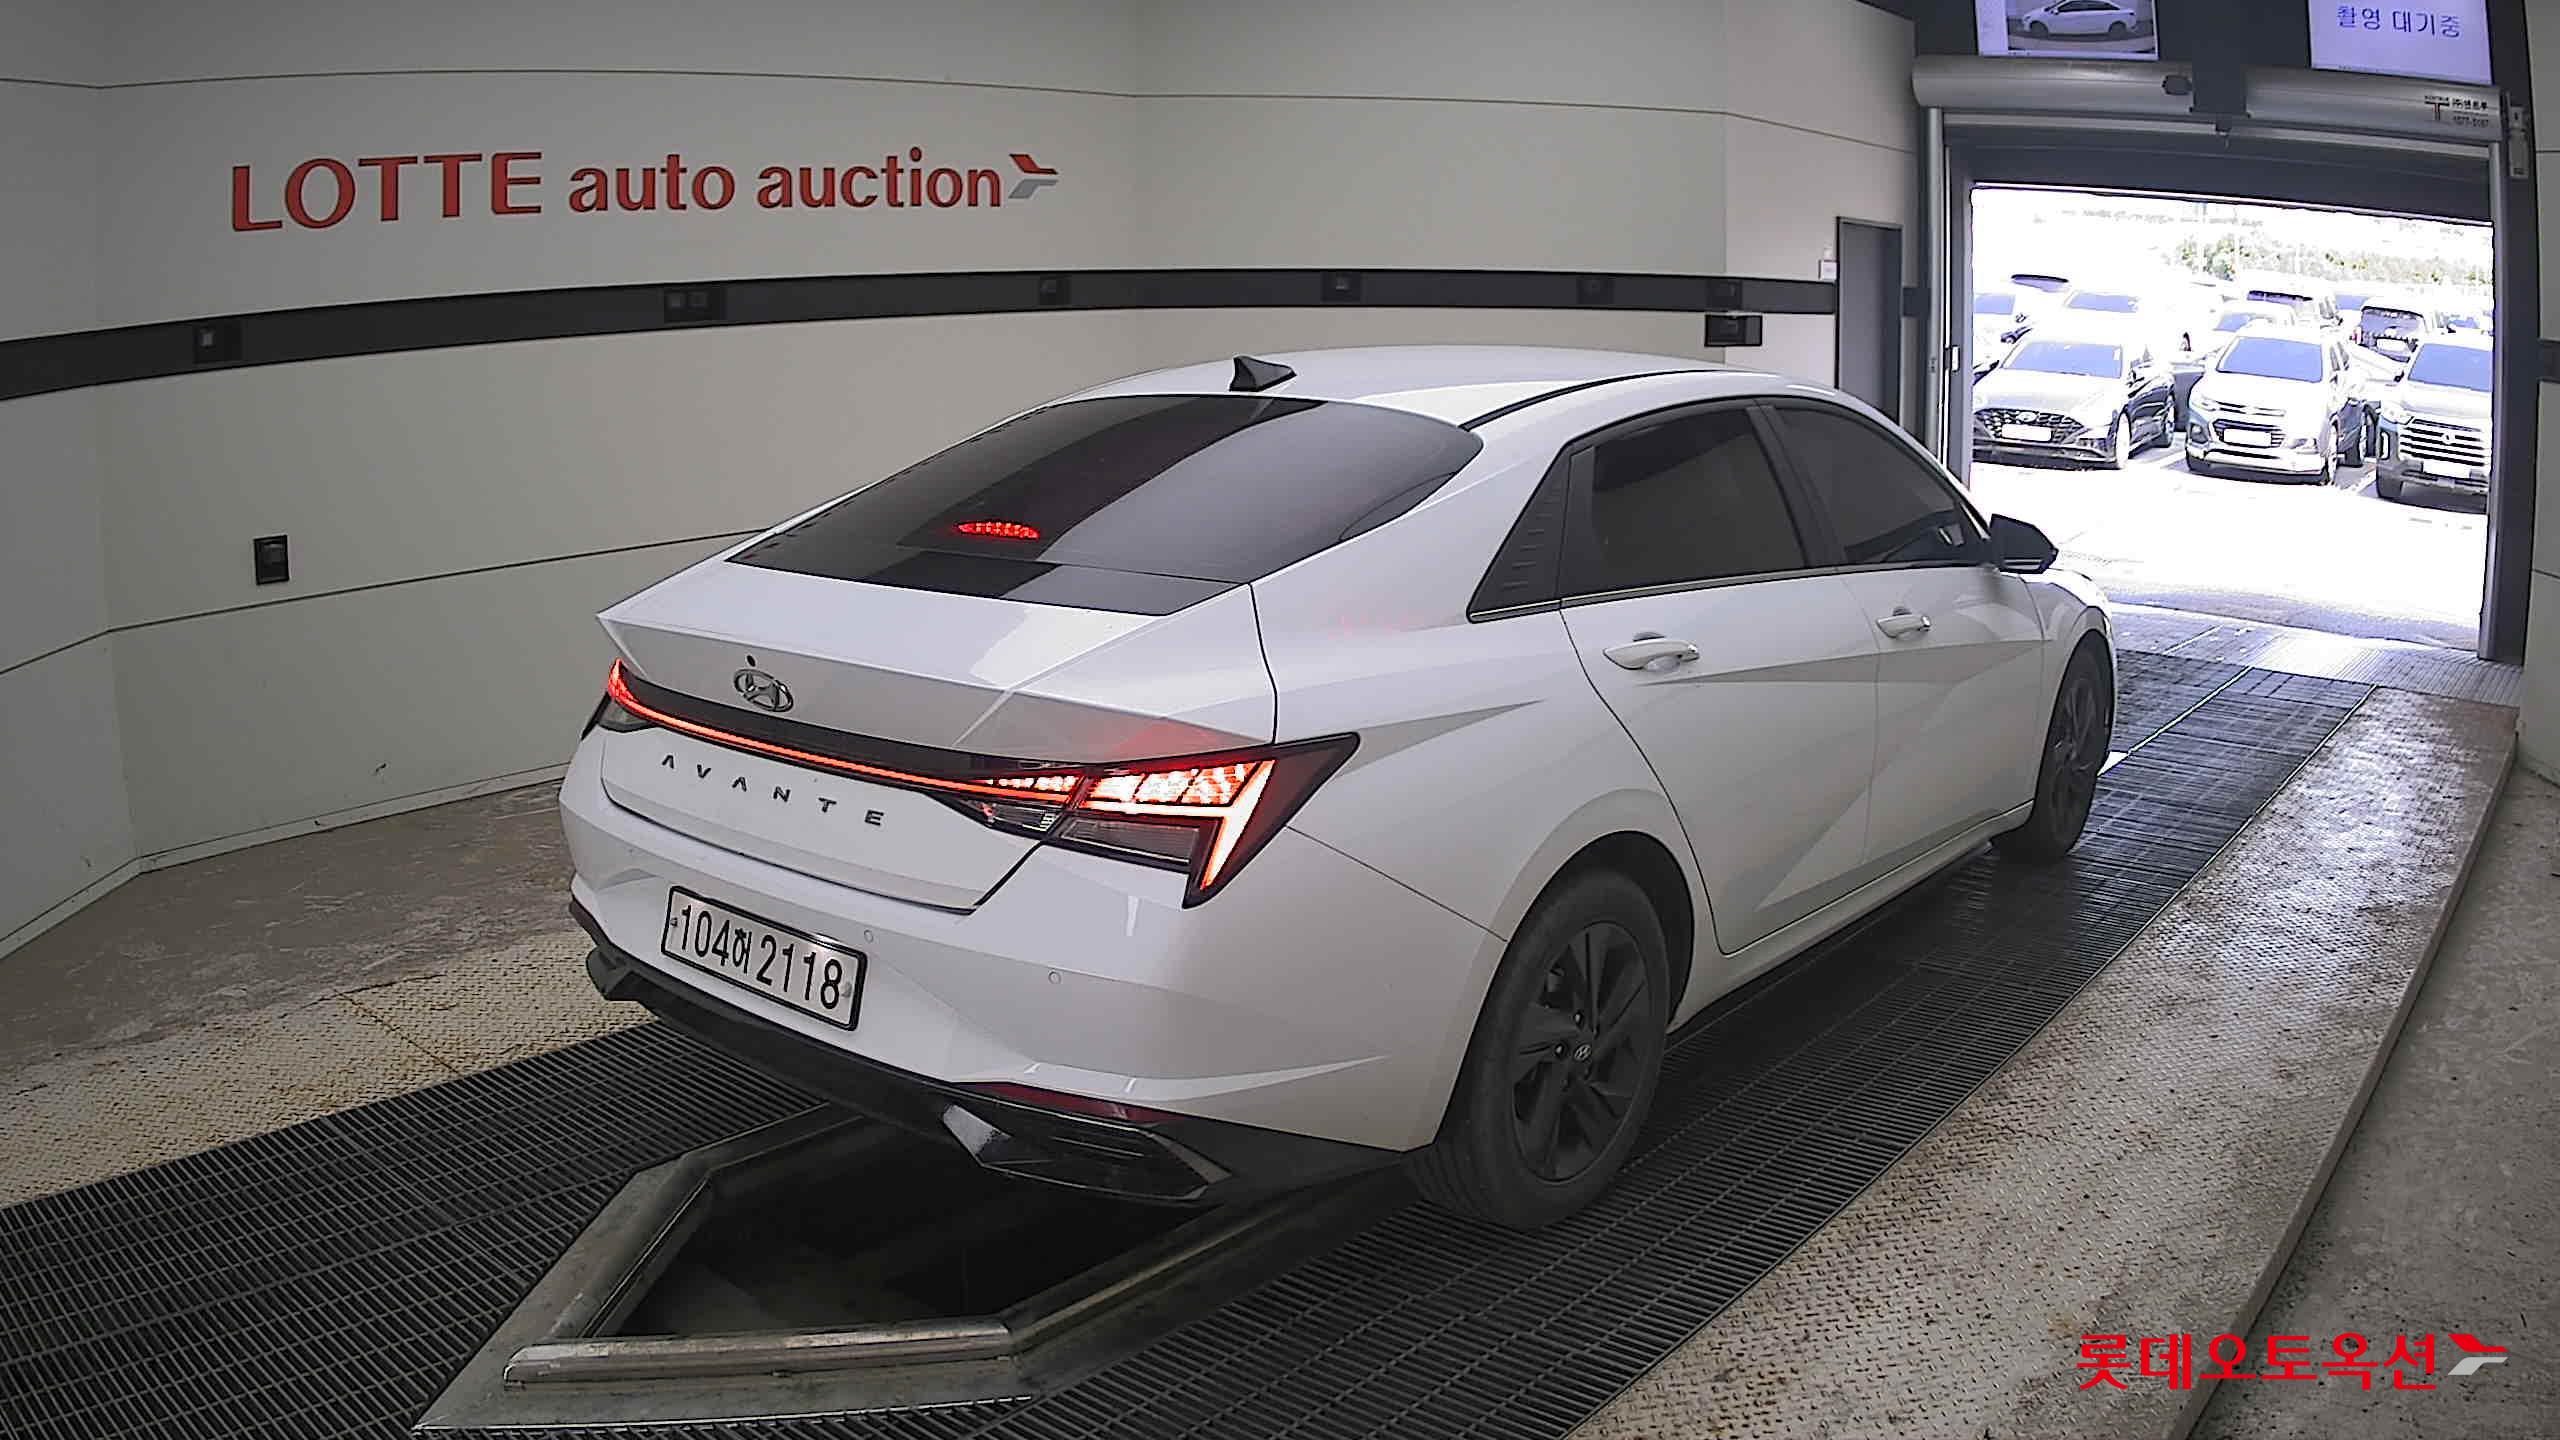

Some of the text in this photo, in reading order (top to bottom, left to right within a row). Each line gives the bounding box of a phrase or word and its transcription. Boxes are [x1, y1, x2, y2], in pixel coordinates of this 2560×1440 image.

[2392, 10, 2461, 38] 대기중
[232, 146, 1004, 233] LOTTE auto auction
